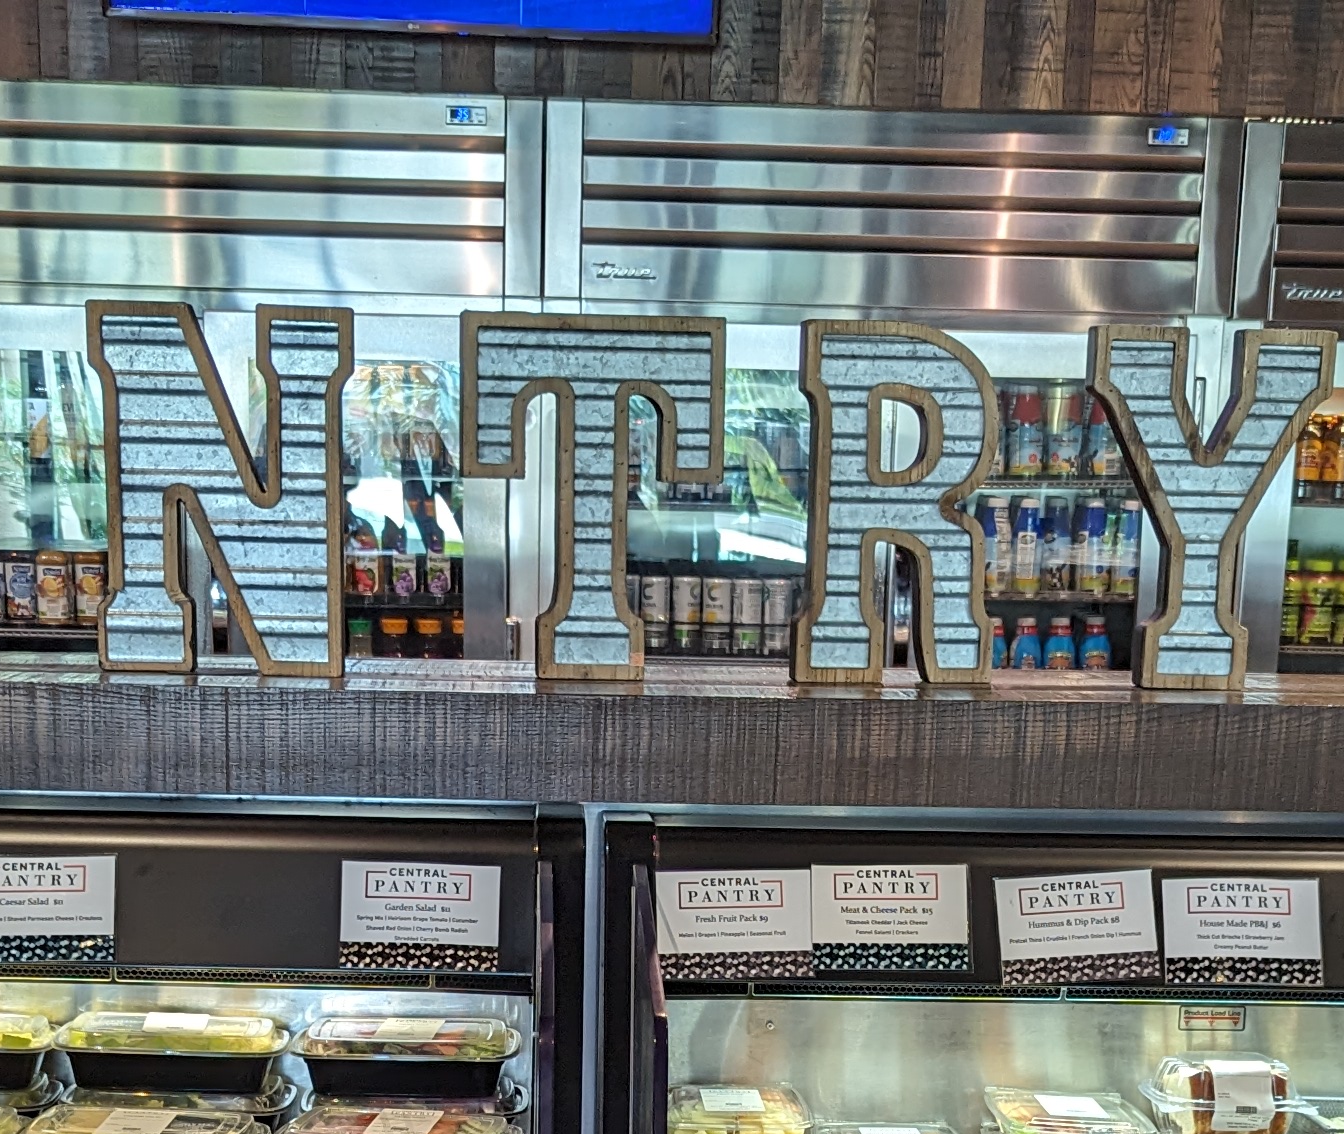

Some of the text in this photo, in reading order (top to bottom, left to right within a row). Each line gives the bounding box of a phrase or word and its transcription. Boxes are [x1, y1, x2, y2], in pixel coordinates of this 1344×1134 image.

[2, 862, 62, 871] CENTRAL
[389, 867, 448, 878] CENTRAL
[856, 869, 915, 879] CENTRAL
[374, 879, 464, 895] PANTRY
[701, 877, 759, 887] CENTRAL
[1041, 880, 1099, 892] CENTRAL
[842, 881, 930, 894] PANTRY
[1210, 883, 1268, 893] CENTRAL
[687, 889, 775, 903] PANTRY
[1028, 891, 1116, 909] PANTRY
[0, 898, 26, 906] Caesar
[27, 898, 49, 906] Salad
[1197, 895, 1283, 909] PANTRY
[385, 903, 414, 911] Garden
[415, 904, 437, 912] Salad
[840, 906, 933, 915] Meat & Cheese Pack $15
[695, 914, 769, 923] Fresh Fruit Pack $9
[1028, 921, 1065, 929] Hummus
[1074, 918, 1089, 927] Dip
[1090, 916, 1109, 925] Pack
[1110, 916, 1120, 924] $8
[1199, 919, 1225, 928] House
[1226, 919, 1248, 928] Made
[1249, 920, 1269, 929] PB&J
